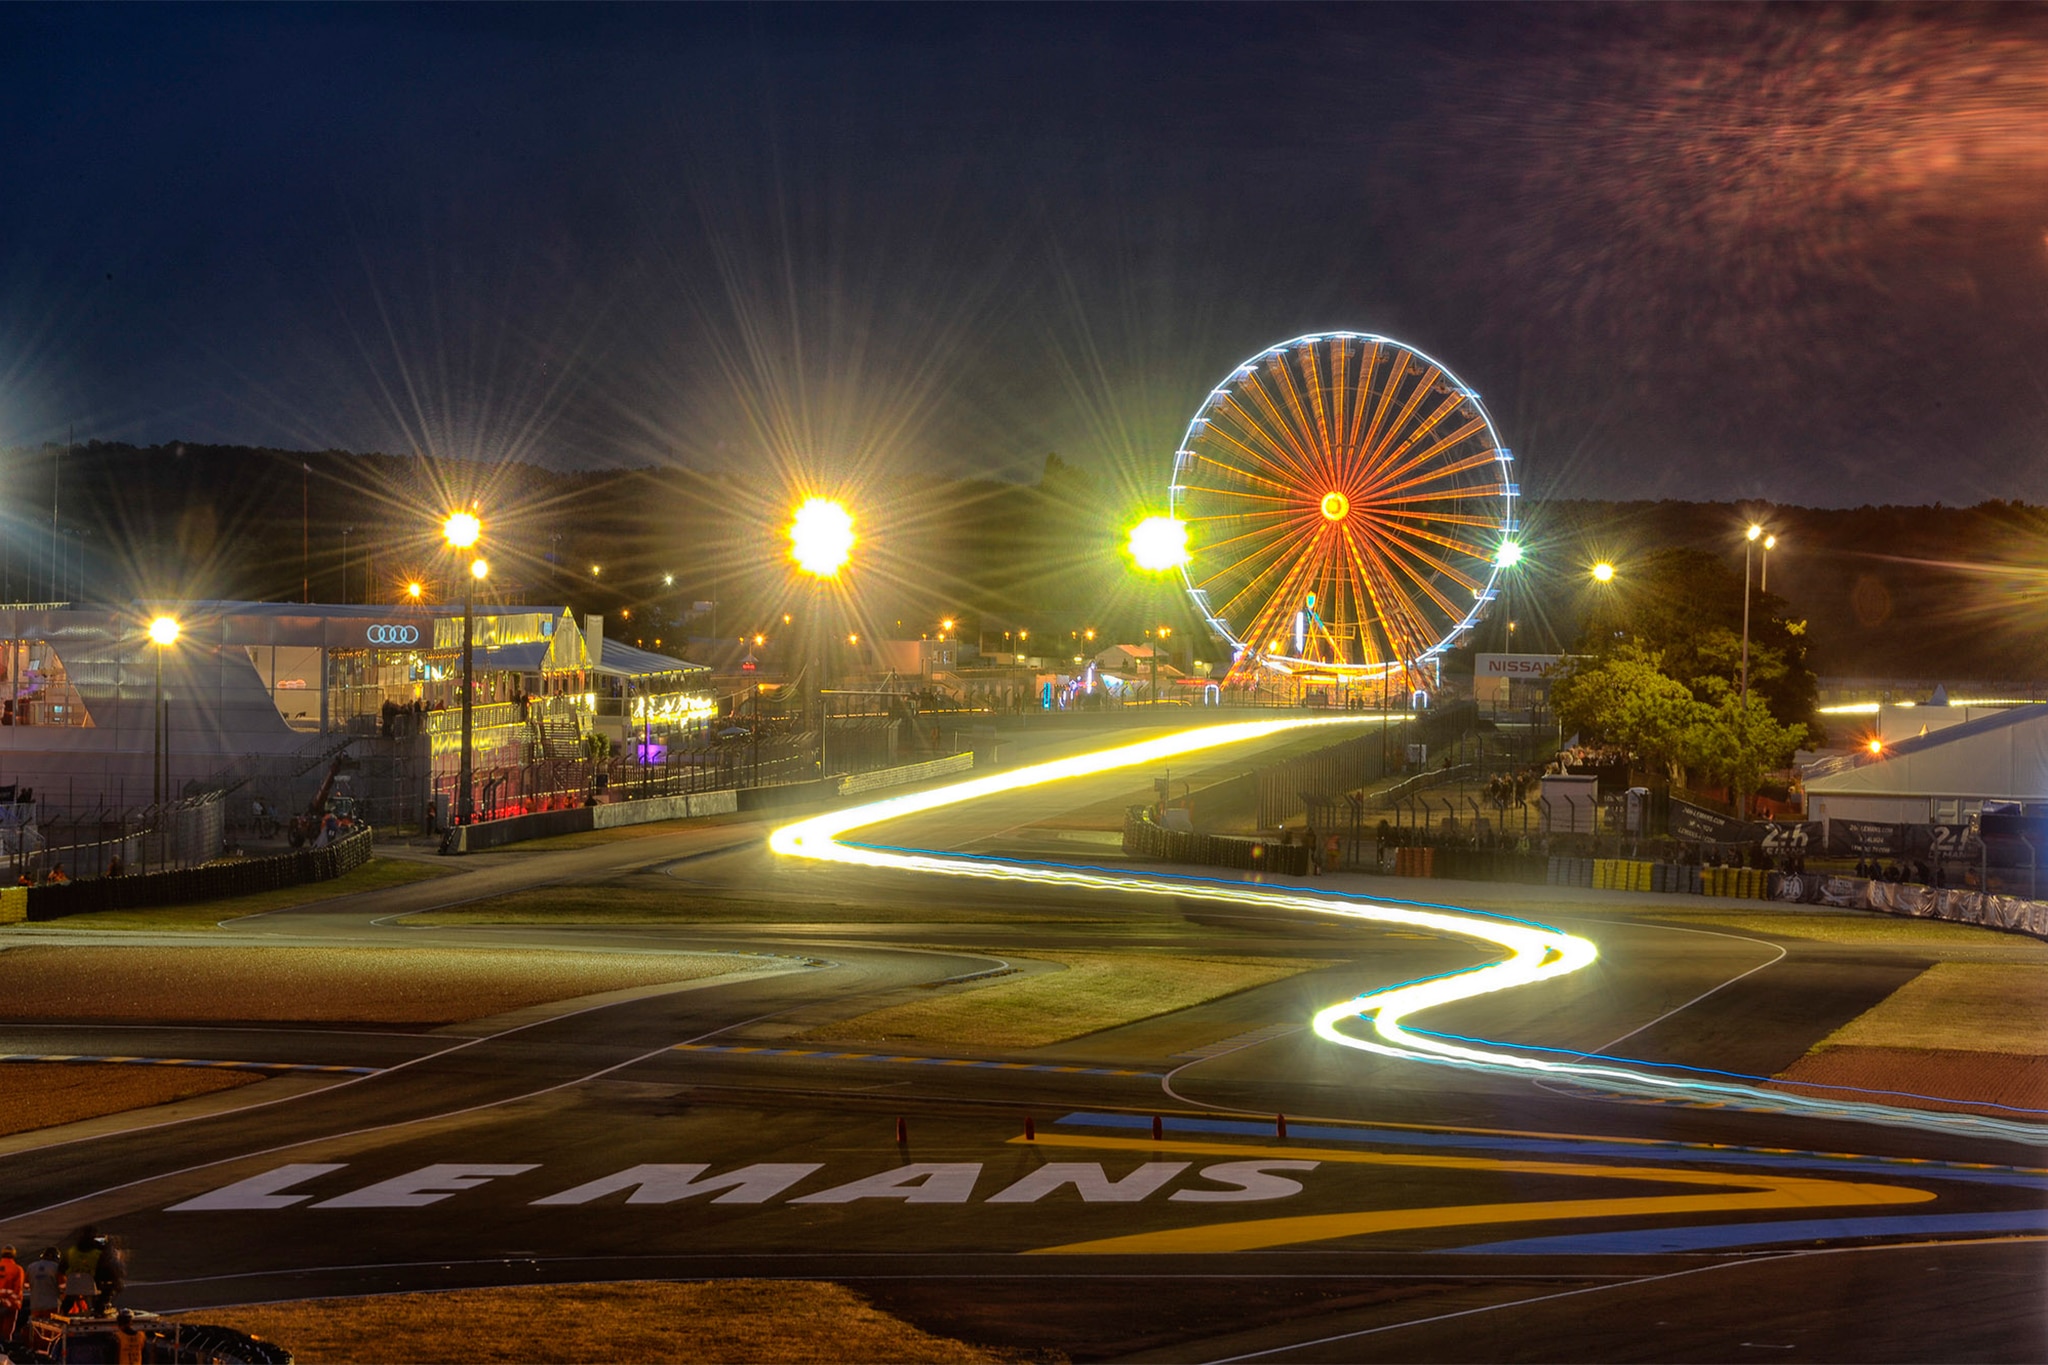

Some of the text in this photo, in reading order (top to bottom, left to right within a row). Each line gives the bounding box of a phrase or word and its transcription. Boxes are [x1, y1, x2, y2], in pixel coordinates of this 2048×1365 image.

[1488, 660, 1557, 673] NISSAN
[1783, 880, 1800, 895] FIA
[162, 1160, 1321, 1211] LE MANS
